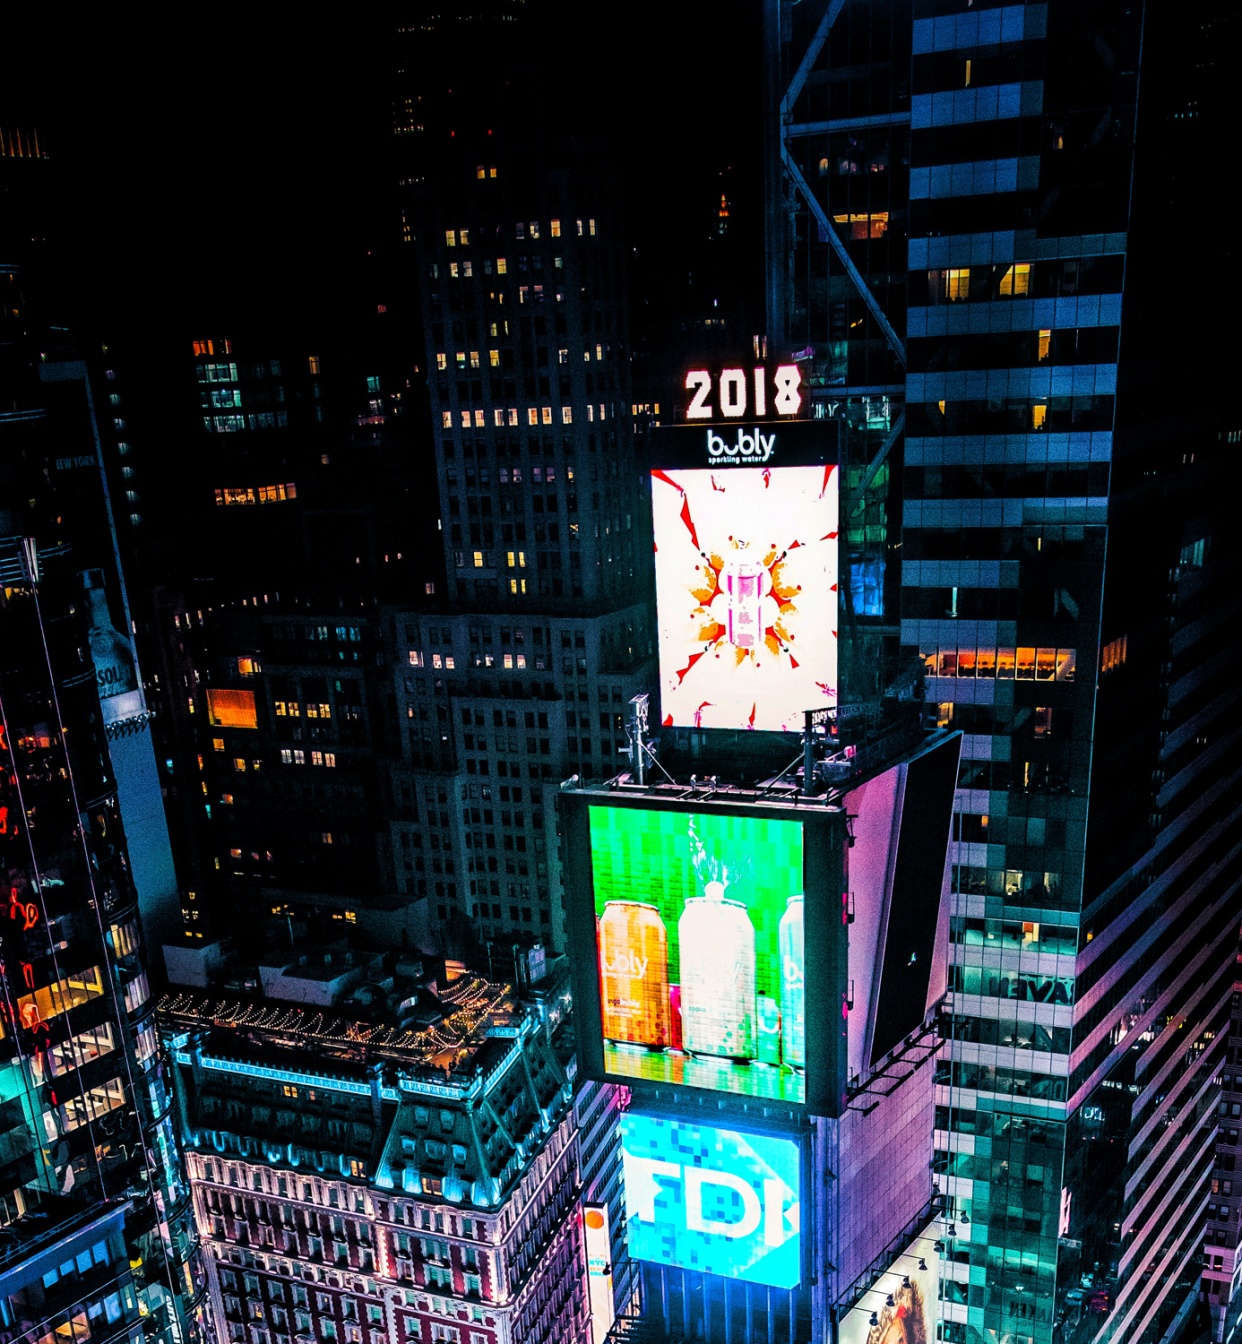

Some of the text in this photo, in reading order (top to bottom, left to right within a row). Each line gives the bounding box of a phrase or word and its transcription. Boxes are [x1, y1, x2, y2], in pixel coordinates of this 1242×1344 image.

[685, 364, 801, 419] 2018
[73, 454, 96, 469] YORK
[707, 427, 776, 462] bubly
